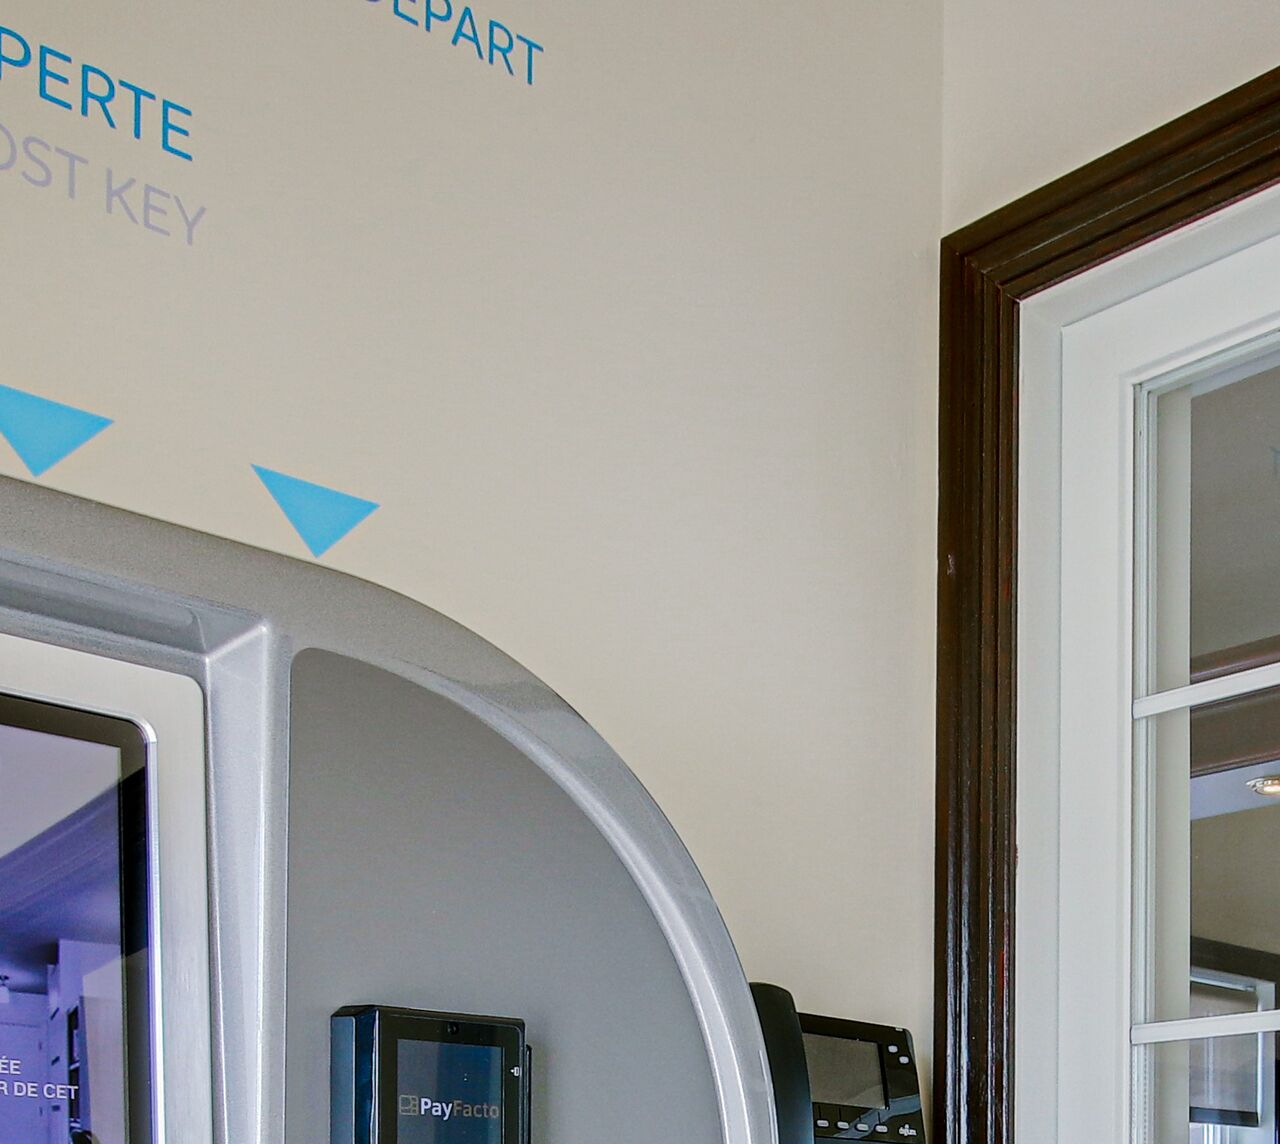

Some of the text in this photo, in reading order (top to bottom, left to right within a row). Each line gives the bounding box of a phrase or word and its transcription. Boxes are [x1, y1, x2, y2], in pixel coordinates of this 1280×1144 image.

[103, 163, 207, 248] KEY
[13, 1082, 39, 1098] DE
[43, 1083, 79, 1101] CET
[420, 1098, 500, 1121] PayFacto
